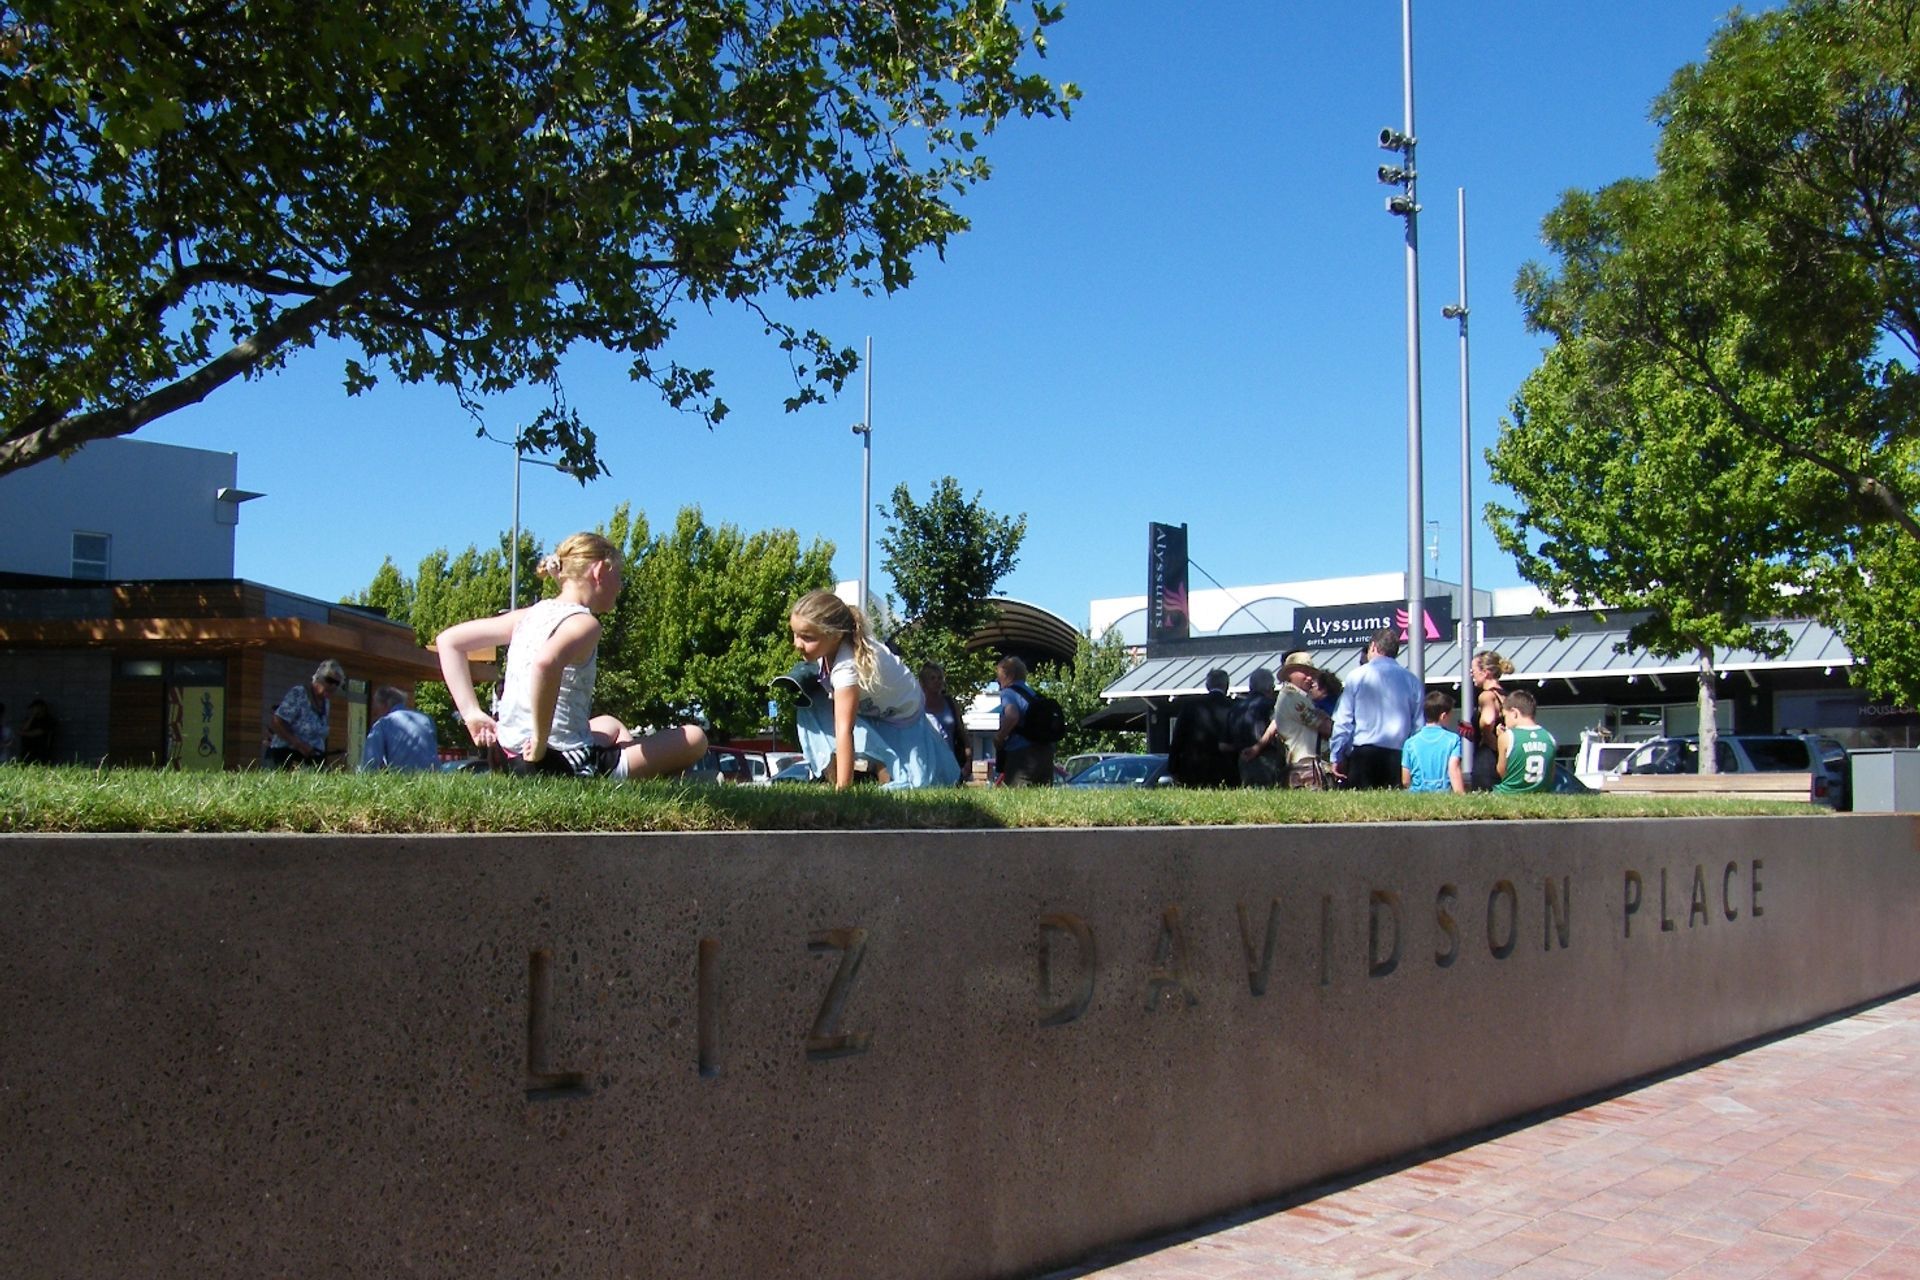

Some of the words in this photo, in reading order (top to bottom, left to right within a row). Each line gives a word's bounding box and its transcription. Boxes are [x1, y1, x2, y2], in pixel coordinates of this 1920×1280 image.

[1154, 527, 1166, 629] Alyssums
[1302, 615, 1391, 637] Alyssums
[1858, 705, 1896, 715] HOUSE
[1524, 755, 1545, 783] 9
[525, 927, 873, 1098] LIZ
[1038, 875, 1570, 1028] DAVIDSON
[1624, 858, 1763, 938] PLACE
